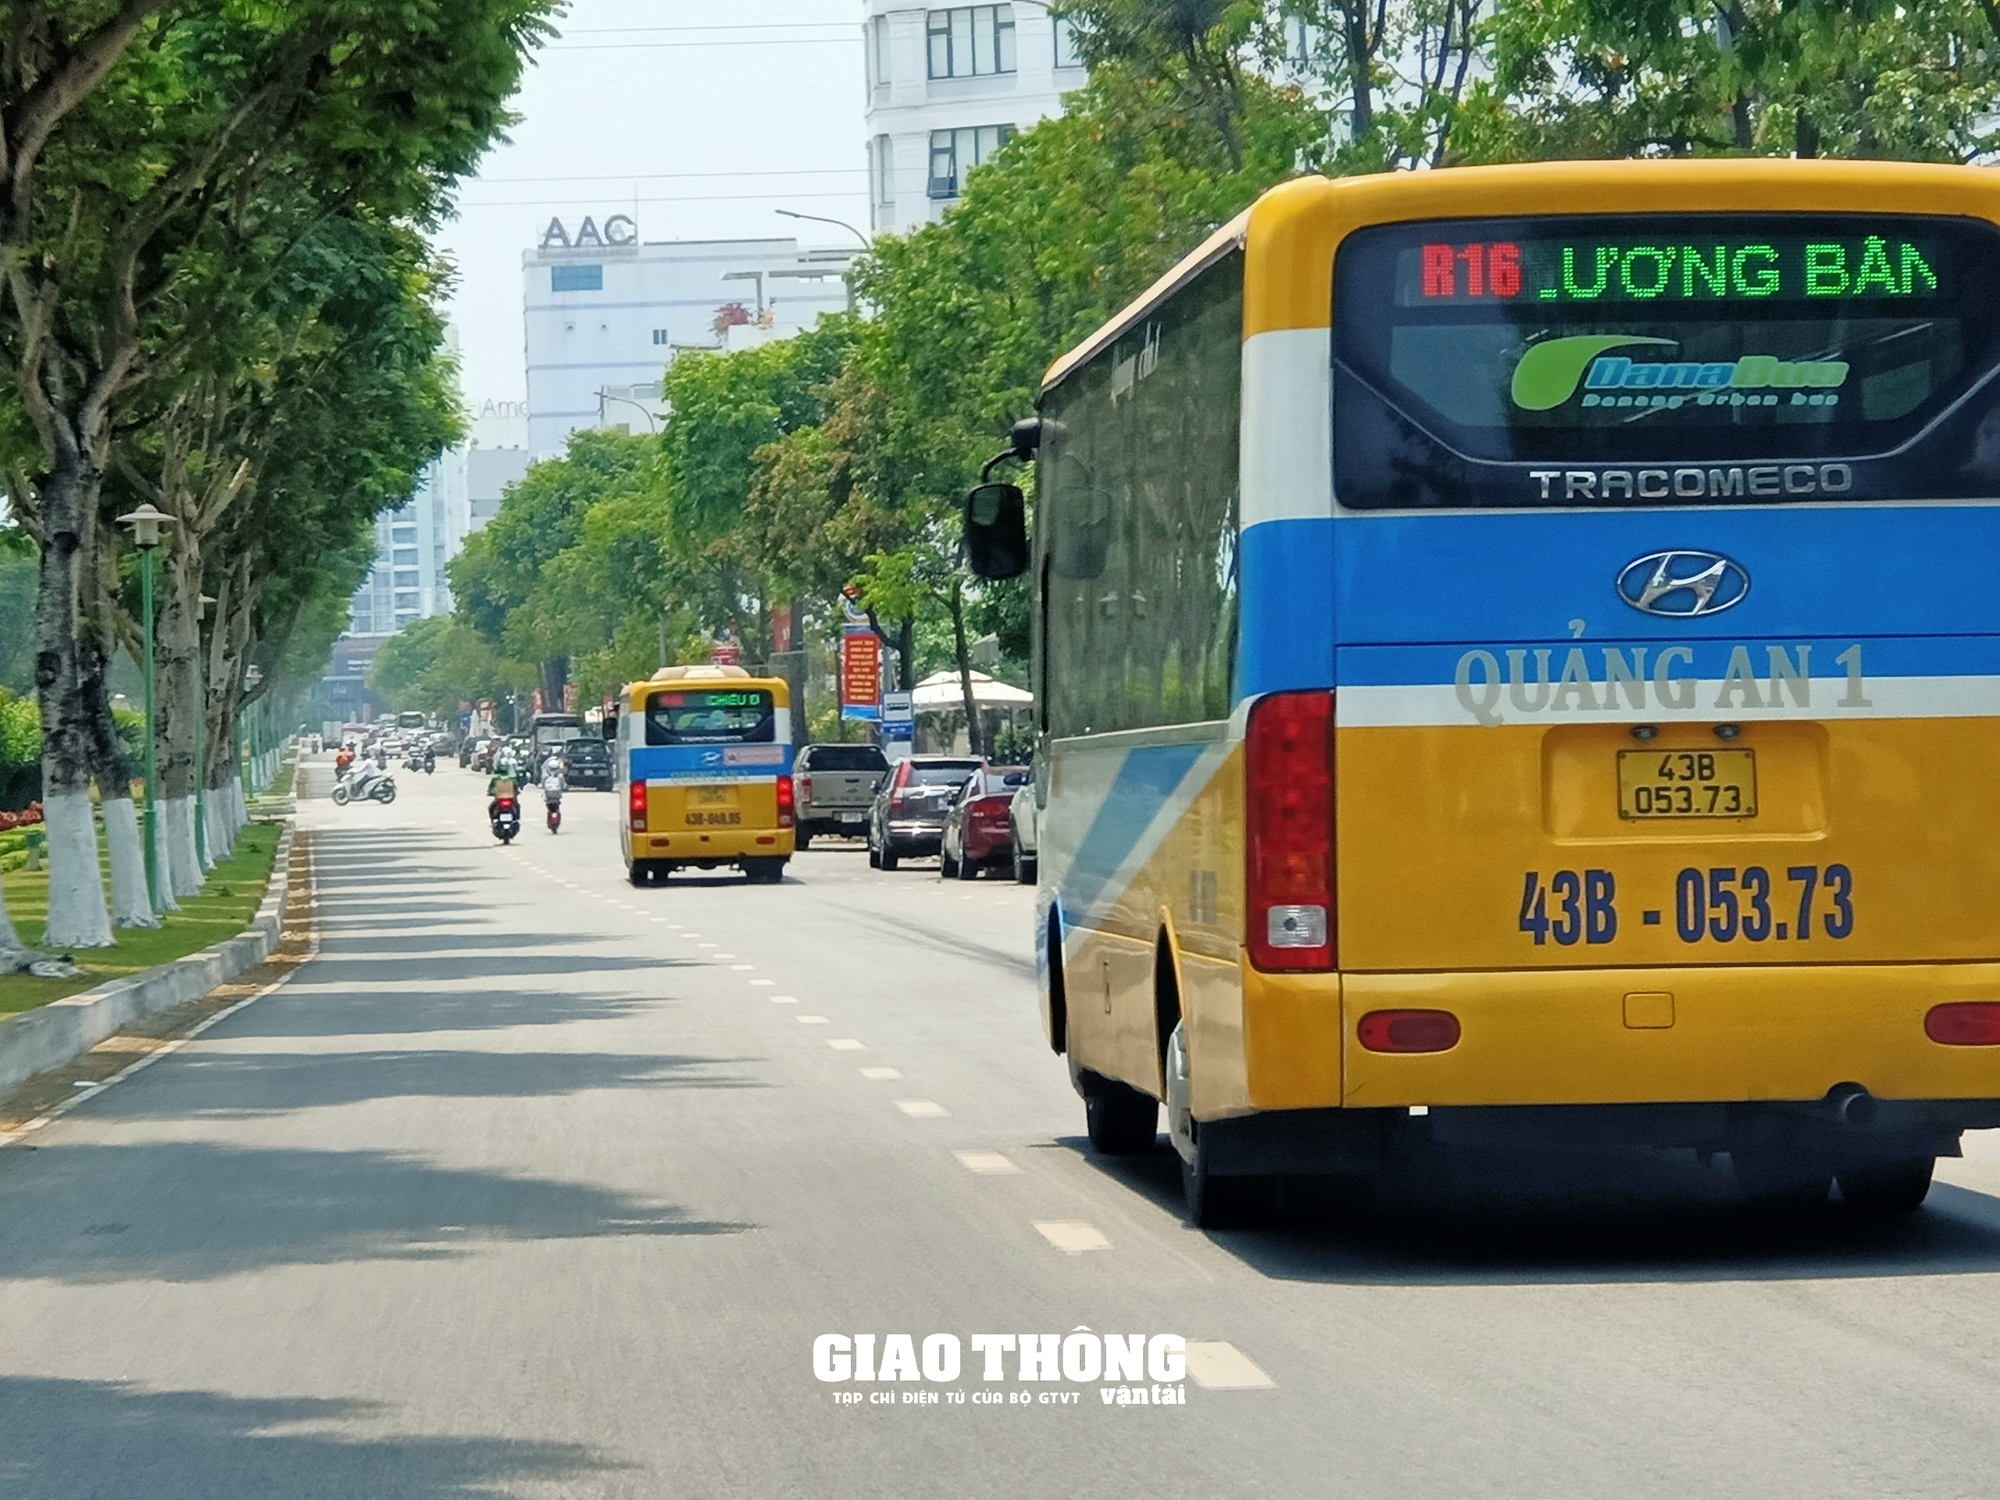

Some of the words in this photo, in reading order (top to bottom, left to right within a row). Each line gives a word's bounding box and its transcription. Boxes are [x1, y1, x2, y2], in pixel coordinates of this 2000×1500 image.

[543, 214, 637, 249] AAC
[1422, 243, 1520, 297] R16
[1539, 245, 1779, 298] ƯƠNG
[1529, 463, 1852, 500] TRACOMECO
[1455, 619, 1698, 728] QUẢNG
[1714, 645, 1812, 710] AN
[1835, 644, 1872, 709] 1
[1658, 754, 1716, 781] 43B
[1634, 785, 1741, 813] 053.73
[1519, 869, 1618, 946] 43B
[1676, 863, 1855, 943] 053.73
